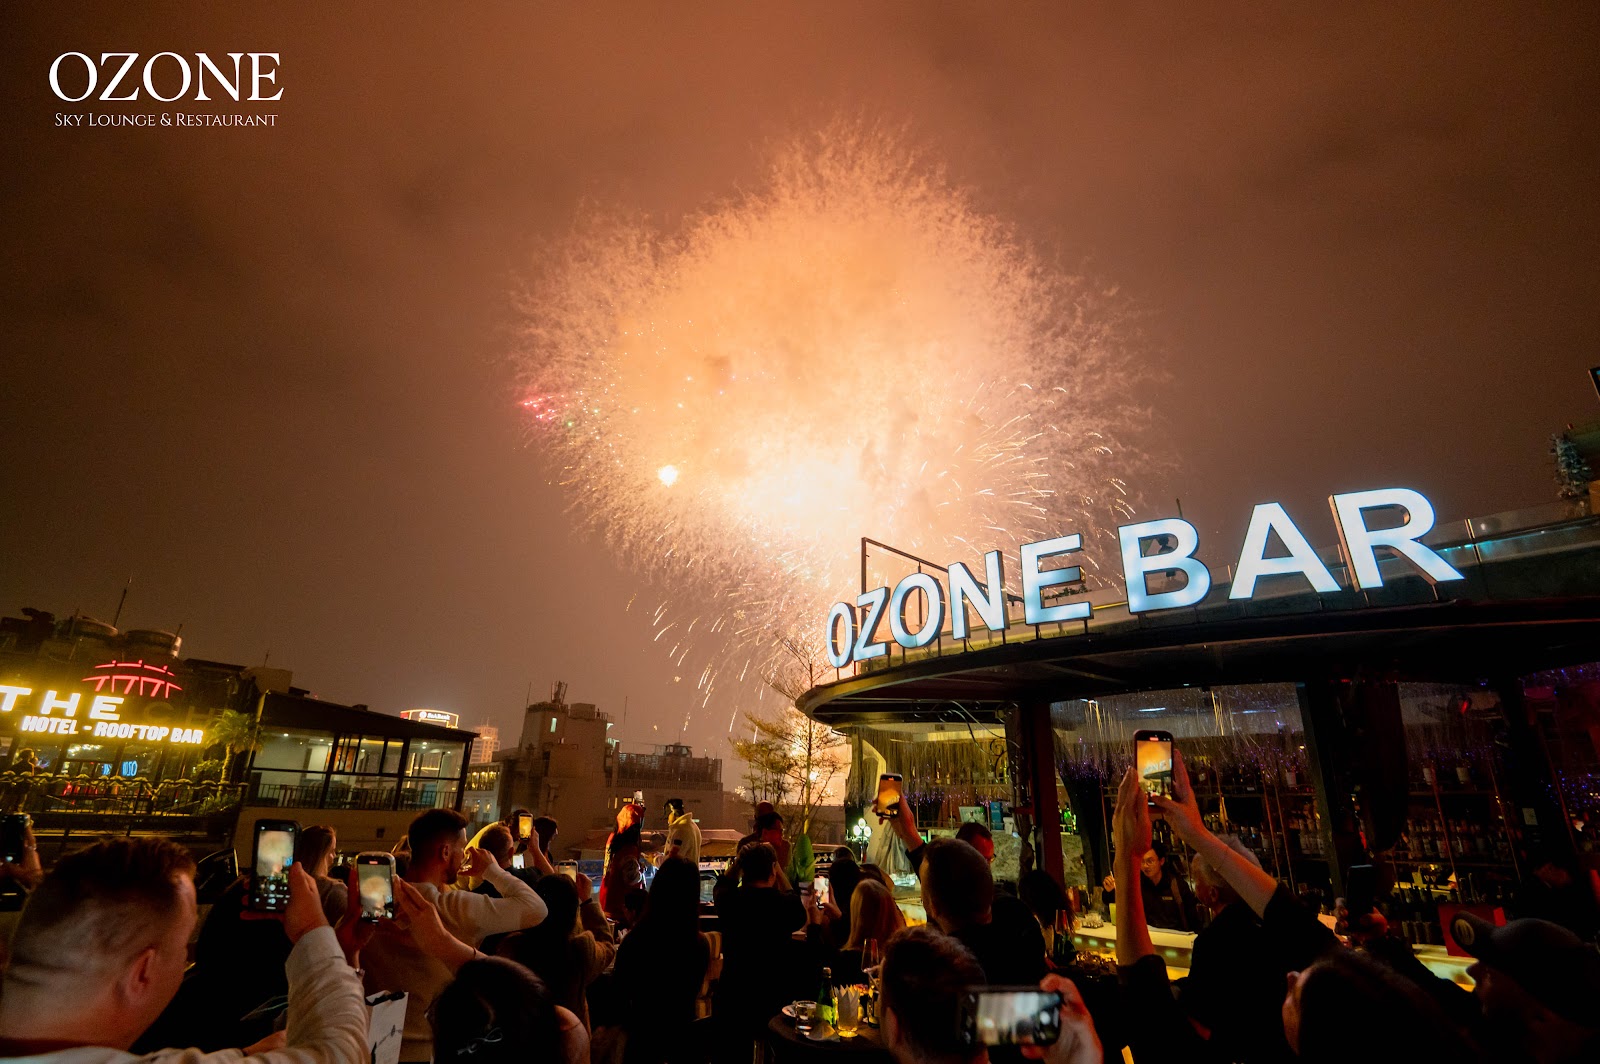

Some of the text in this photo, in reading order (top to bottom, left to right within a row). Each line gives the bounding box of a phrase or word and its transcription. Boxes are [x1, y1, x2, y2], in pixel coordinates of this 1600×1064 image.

[826, 487, 1465, 669] OZONE BAR
[0, 684, 125, 721] THE
[22, 715, 79, 735] HOTEL
[94, 721, 170, 741] ROOFTOP
[170, 727, 204, 744] BAR
